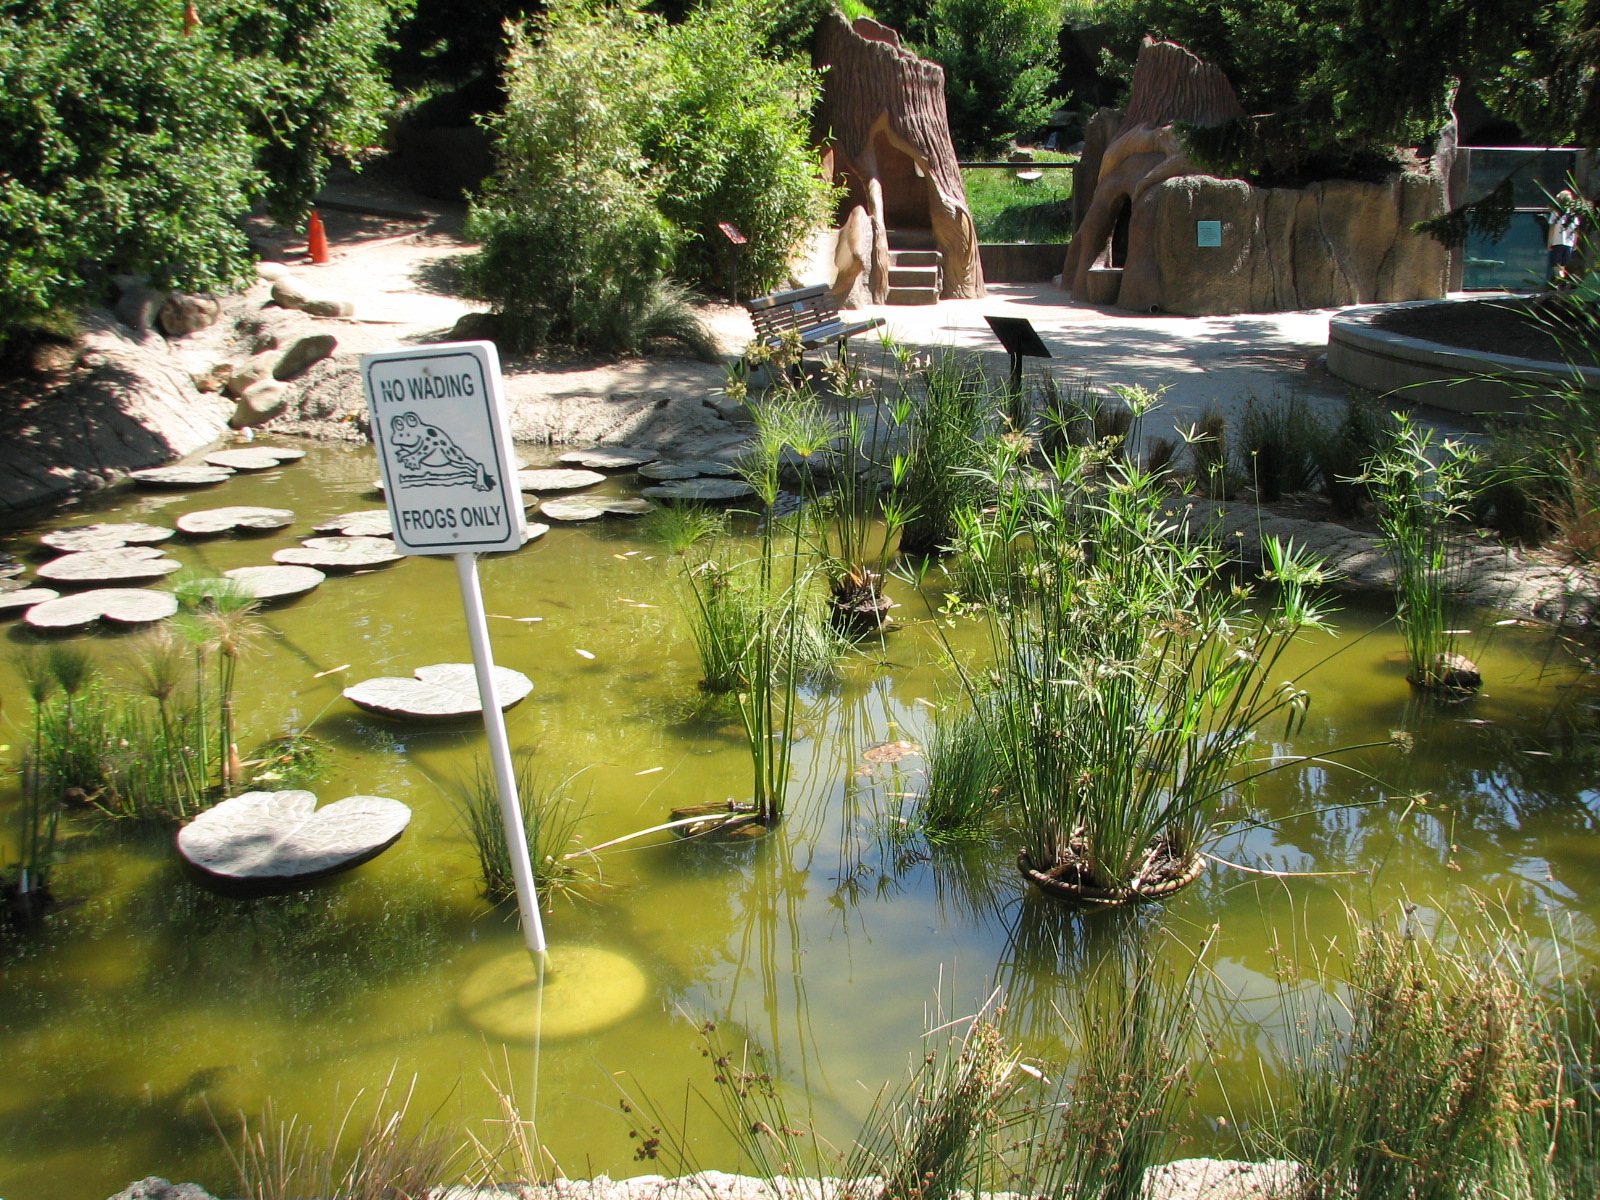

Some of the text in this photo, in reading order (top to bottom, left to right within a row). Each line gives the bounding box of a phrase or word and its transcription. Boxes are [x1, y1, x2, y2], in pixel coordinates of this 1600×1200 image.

[380, 373, 475, 403] NO WADING
[402, 506, 501, 530] FROGS ONLY
